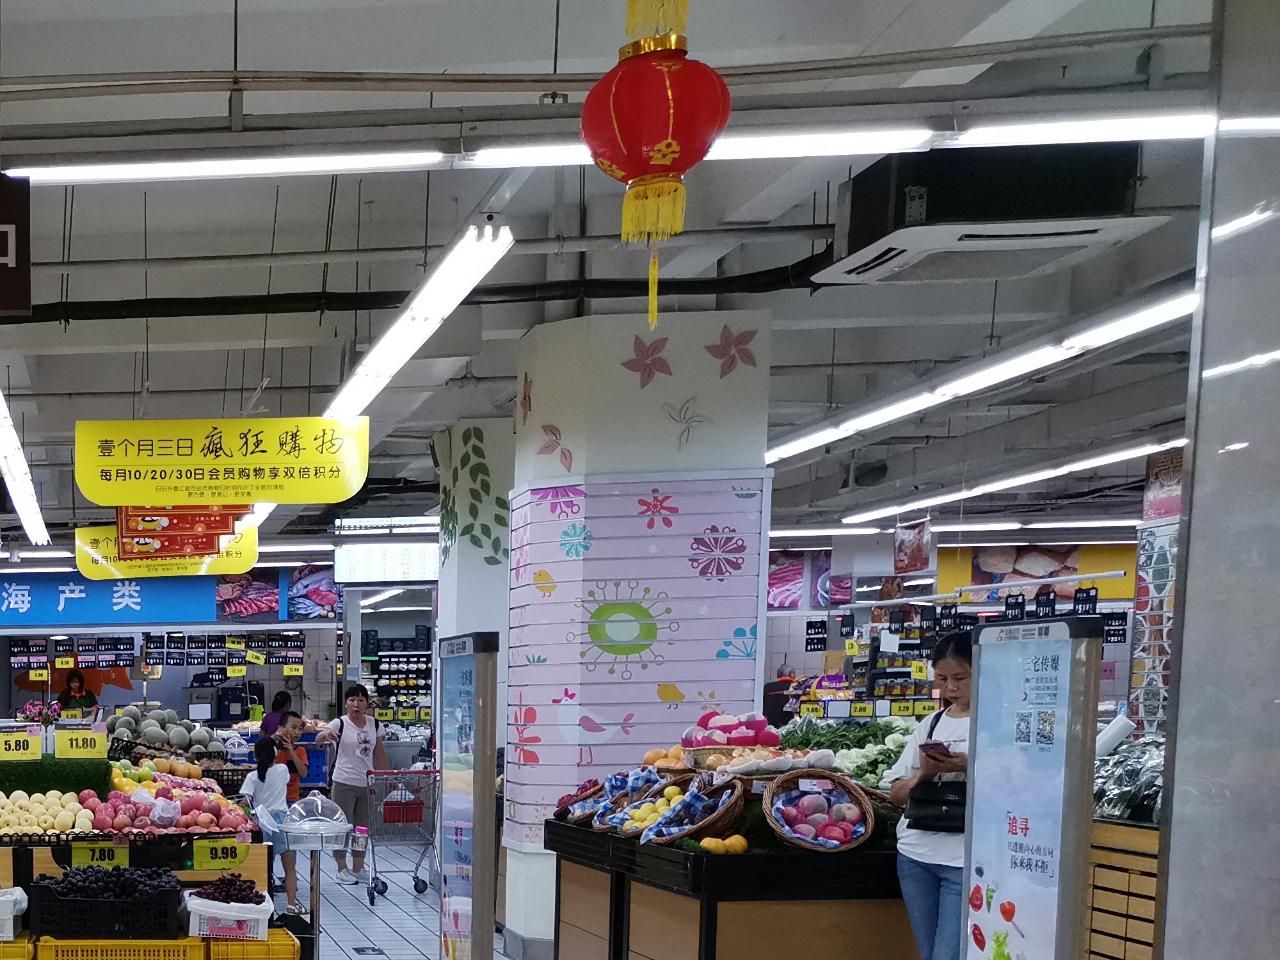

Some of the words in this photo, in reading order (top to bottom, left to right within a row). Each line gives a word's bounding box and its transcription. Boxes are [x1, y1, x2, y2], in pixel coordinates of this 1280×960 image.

[98, 437, 194, 458] 壹个月三日
[99, 465, 342, 482] 每月10/20/30日会员购物享双倍积分
[1, 581, 142, 614] 海产类
[3, 739, 30, 752] 5.80
[67, 737, 97, 750] 11.80
[89, 848, 115, 862] 7.80
[209, 846, 238, 860] 9.98
